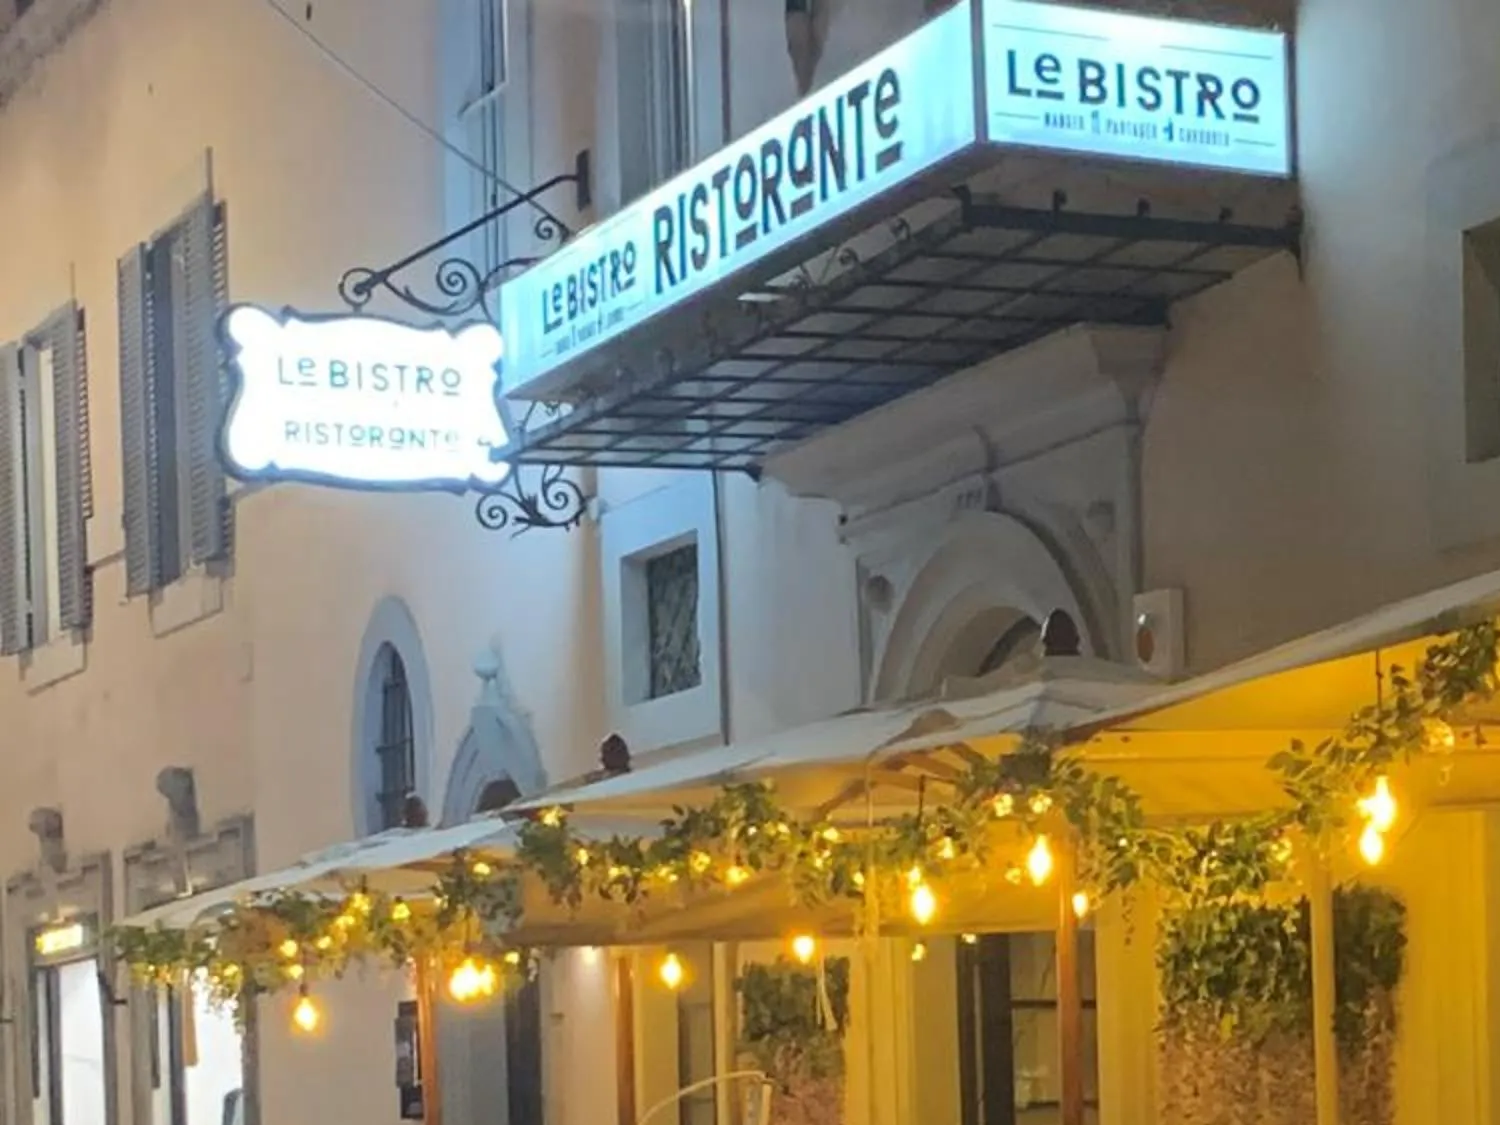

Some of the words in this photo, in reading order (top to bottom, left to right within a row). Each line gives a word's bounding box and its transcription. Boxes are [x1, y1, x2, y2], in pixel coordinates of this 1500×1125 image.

[1007, 50, 1064, 101] Le
[1077, 58, 1260, 124] BISTRO
[542, 282, 563, 335] Le
[567, 240, 636, 320] BISTRO
[278, 356, 317, 387] Le
[329, 360, 461, 396] BISTRO
